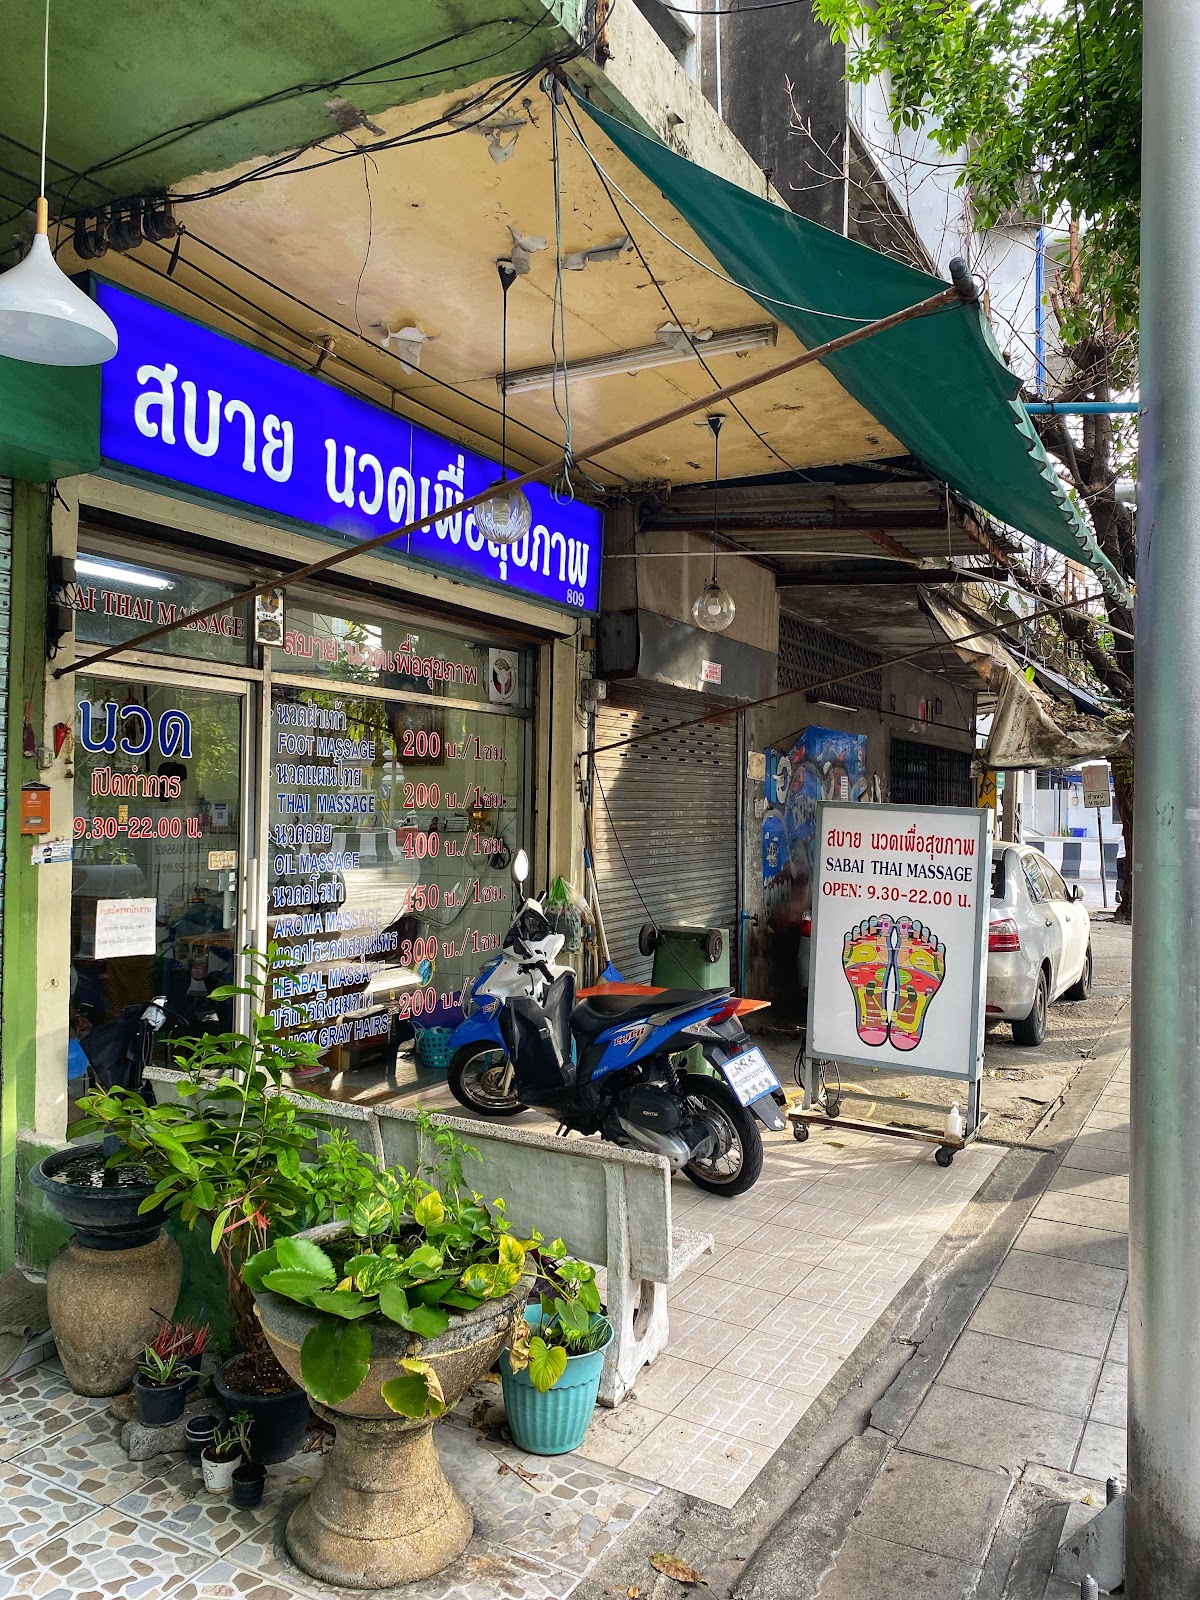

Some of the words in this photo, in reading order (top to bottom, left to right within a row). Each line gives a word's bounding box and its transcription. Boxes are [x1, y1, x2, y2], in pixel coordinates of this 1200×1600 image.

[134, 363, 294, 483] สบาย
[566, 588, 585, 607] 809
[101, 590, 153, 623] THAI
[157, 601, 244, 639] MASSAGE
[284, 630, 338, 662] สบาย
[346, 633, 478, 689] นวดเพื่อสุขภาพ
[78, 700, 192, 758] นวด
[277, 699, 347, 731] นวดฝ่าเท้า
[278, 733, 314, 756] FOOT
[317, 737, 375, 759] MASSAGE
[403, 729, 440, 757] 200
[91, 766, 181, 797] เปิดทำการ
[276, 757, 362, 786] นวดแผนไทย
[277, 793, 310, 813] THAI
[317, 794, 375, 813] MASSAGE
[403, 783, 440, 808] 200
[73, 817, 181, 839] 9.30-22.00
[187, 818, 202, 838] น.
[275, 824, 332, 845] นวดออย
[827, 828, 862, 848] สบาย
[871, 824, 975, 860] นวดเพื่อสุขภาพ
[402, 832, 440, 859] 400
[274, 854, 296, 875] OIL
[299, 852, 360, 874] MASSAGE
[825, 857, 864, 873] SABAI
[871, 860, 902, 877] THAI
[907, 863, 973, 882] MASSAGE
[272, 873, 344, 908] นวดอโรม่า
[402, 884, 439, 912] 450
[822, 881, 862, 898] OPEN:
[867, 885, 952, 906] 9.30-22.00
[958, 893, 971, 908] น.
[273, 913, 323, 939] AROMA
[325, 907, 382, 932] MASSAGE
[401, 936, 437, 966] 300
[273, 971, 326, 999] HERBAL
[328, 960, 386, 989] MASSAGE
[399, 987, 436, 1020] 200
[319, 1022, 353, 1048] GRAY
[354, 1014, 388, 1040] HAIRS
